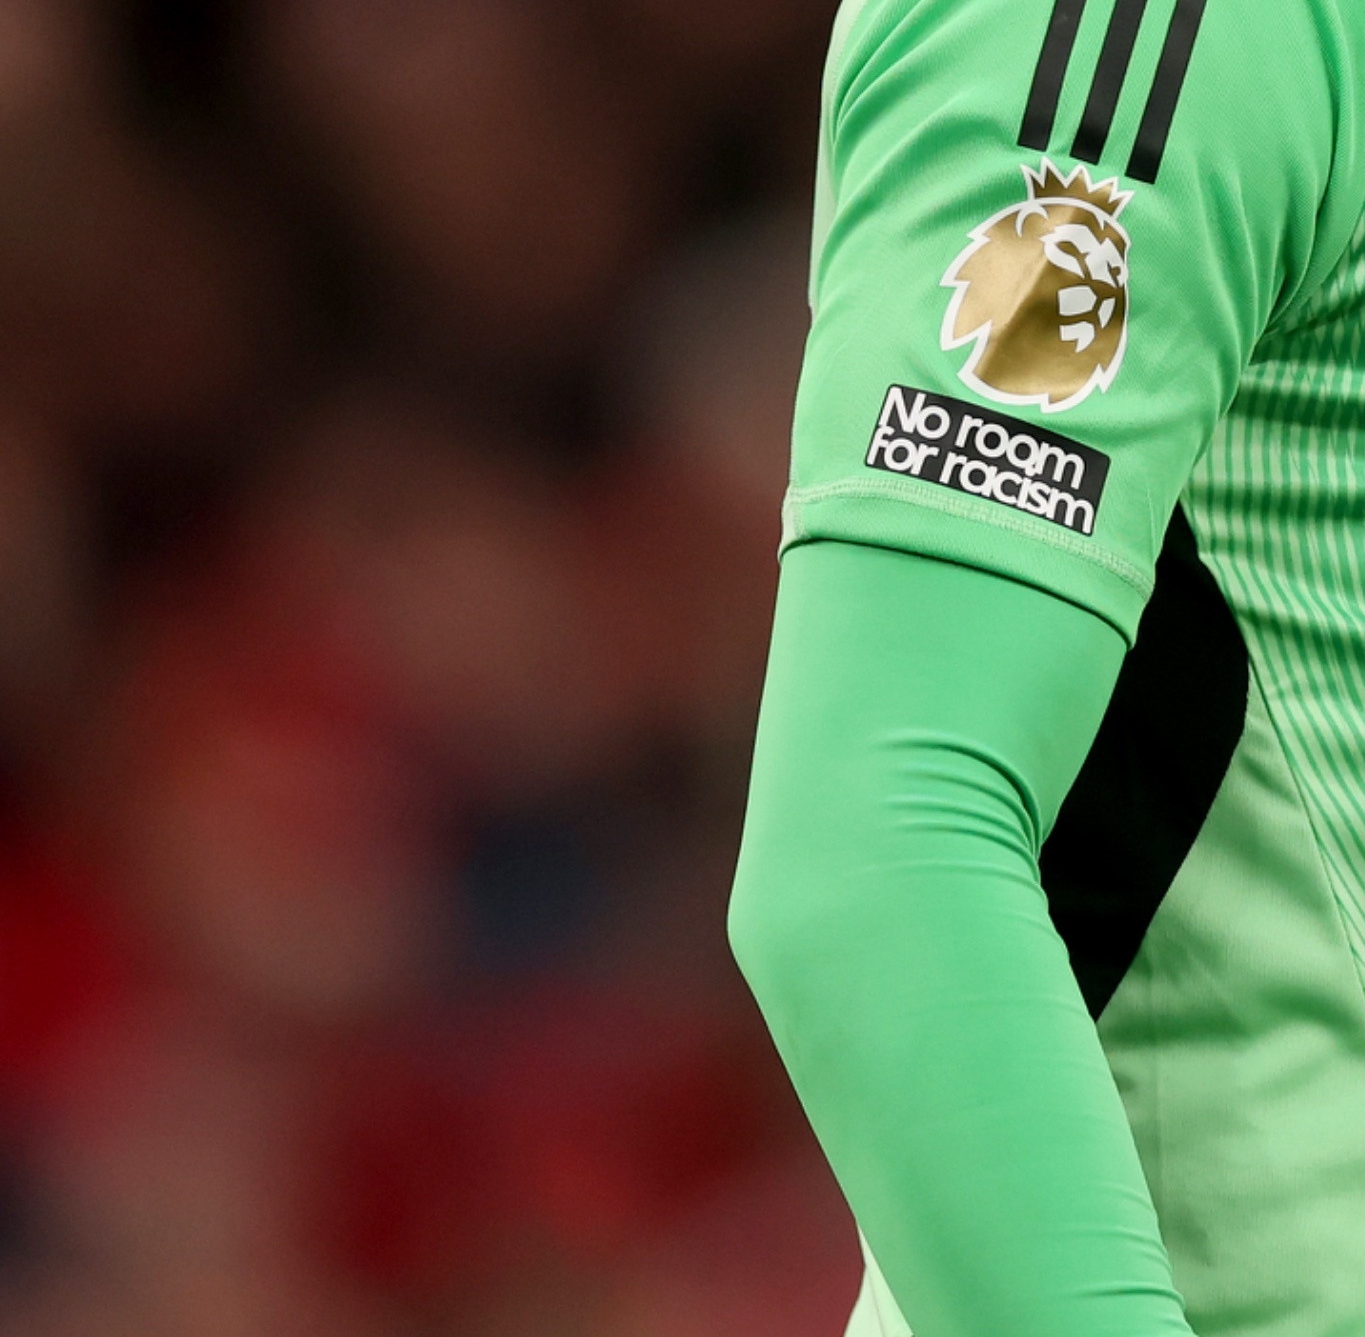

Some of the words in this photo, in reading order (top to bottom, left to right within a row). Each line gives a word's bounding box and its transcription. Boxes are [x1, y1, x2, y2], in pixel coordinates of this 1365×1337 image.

[867, 426, 938, 475] for
[940, 450, 1095, 534] racism
[878, 387, 951, 439] No
[955, 414, 1085, 490] room
